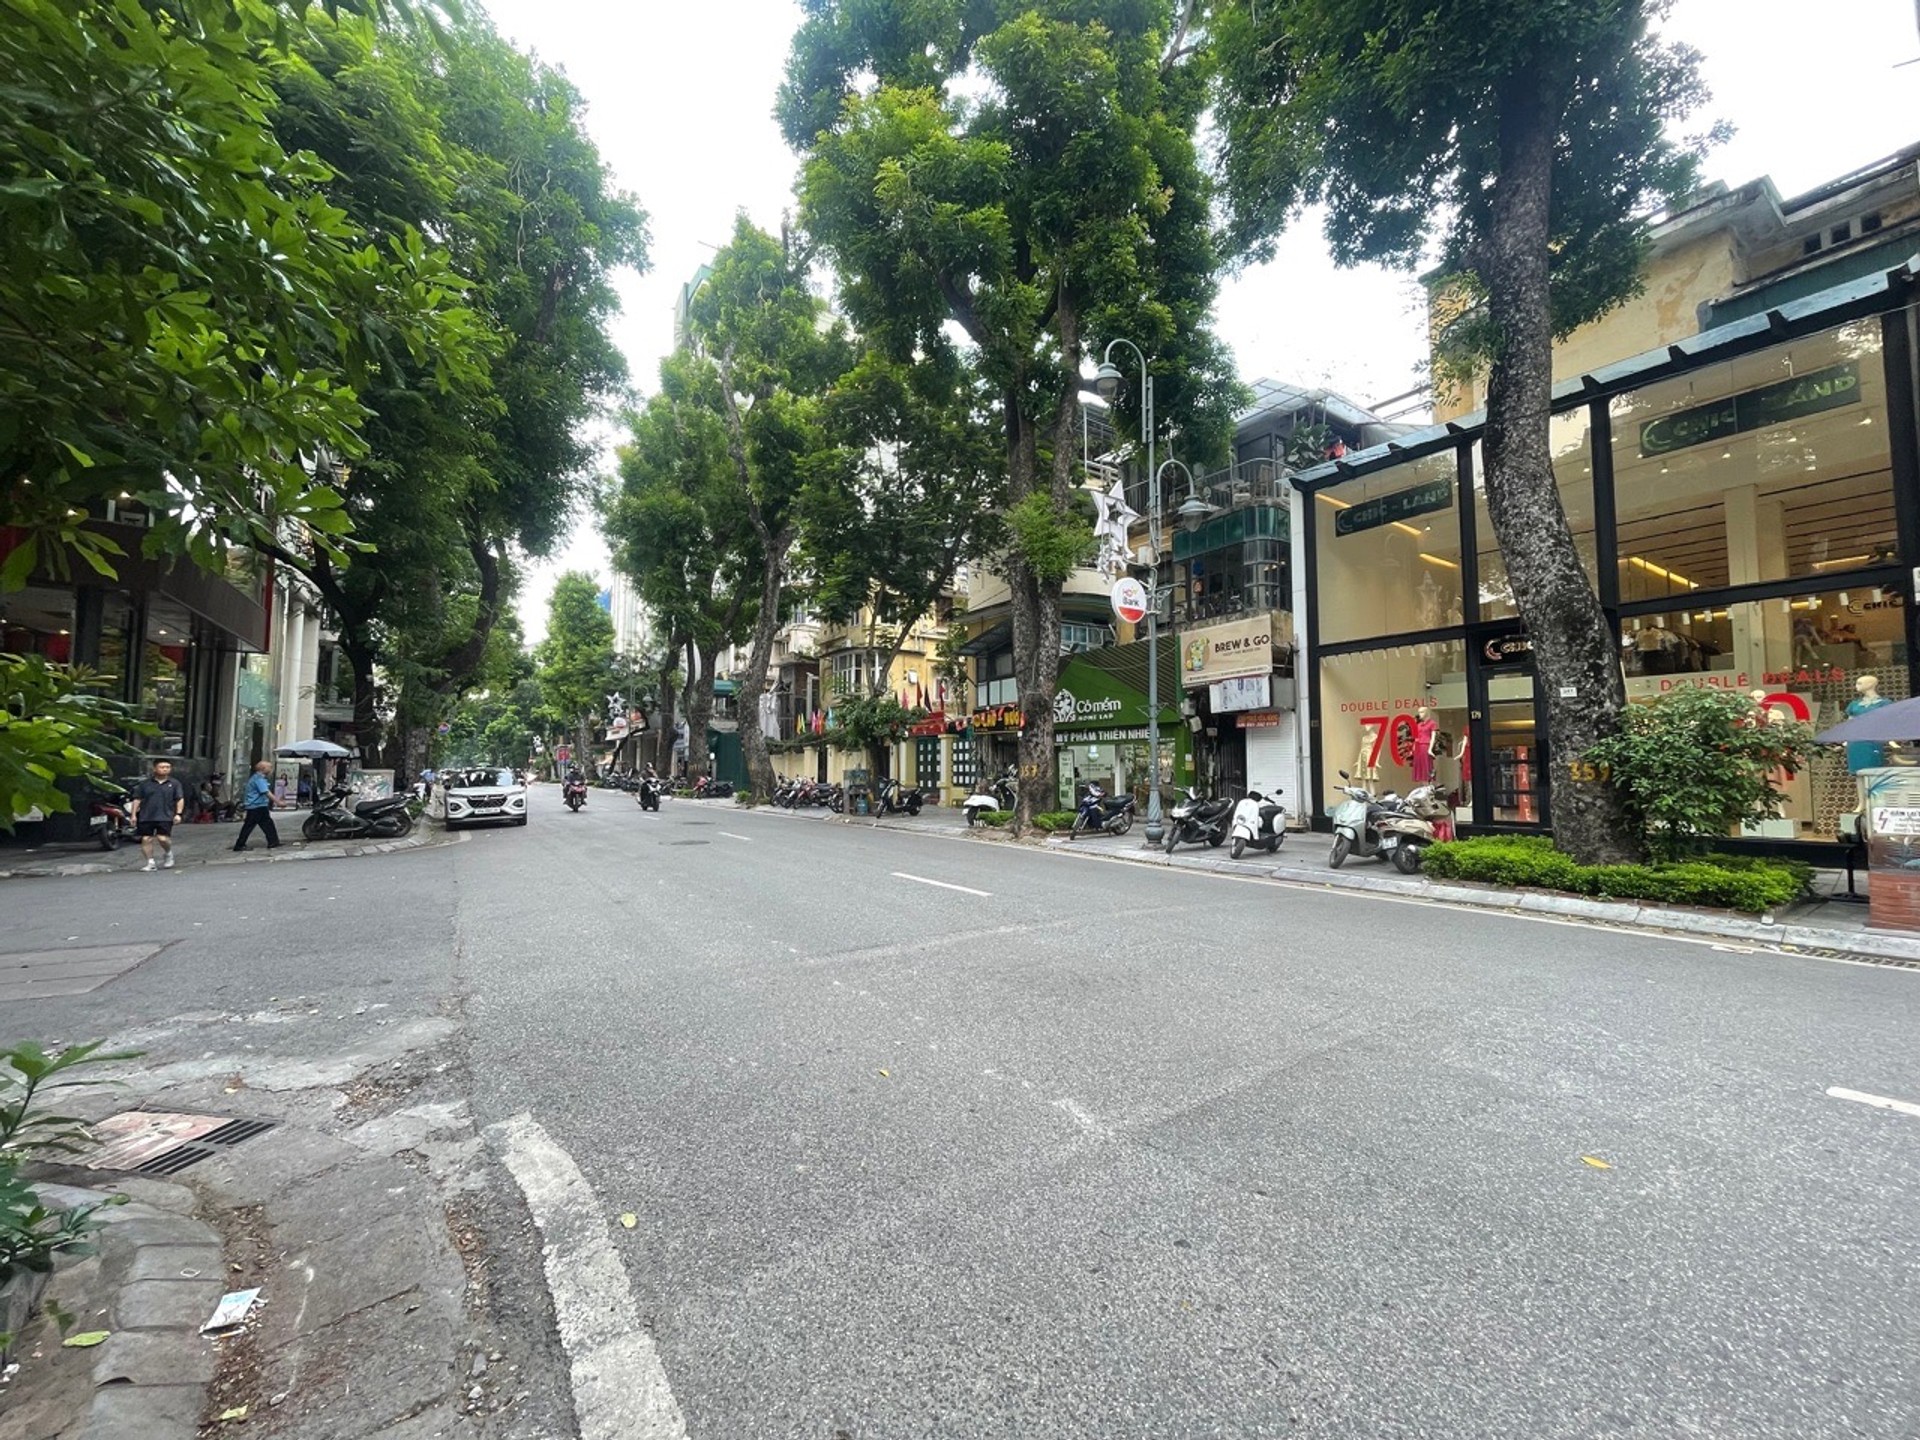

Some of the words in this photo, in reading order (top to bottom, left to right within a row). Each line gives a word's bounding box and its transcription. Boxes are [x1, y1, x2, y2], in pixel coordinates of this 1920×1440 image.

[1215, 638, 1242, 653] BREW
[1243, 637, 1251, 648] &
[1253, 634, 1270, 646] GO
[1762, 667, 1845, 686] DEALS
[1341, 701, 1388, 712] DOUBLE
[1395, 697, 1438, 709] DEALS
[1360, 713, 1419, 768] 70
